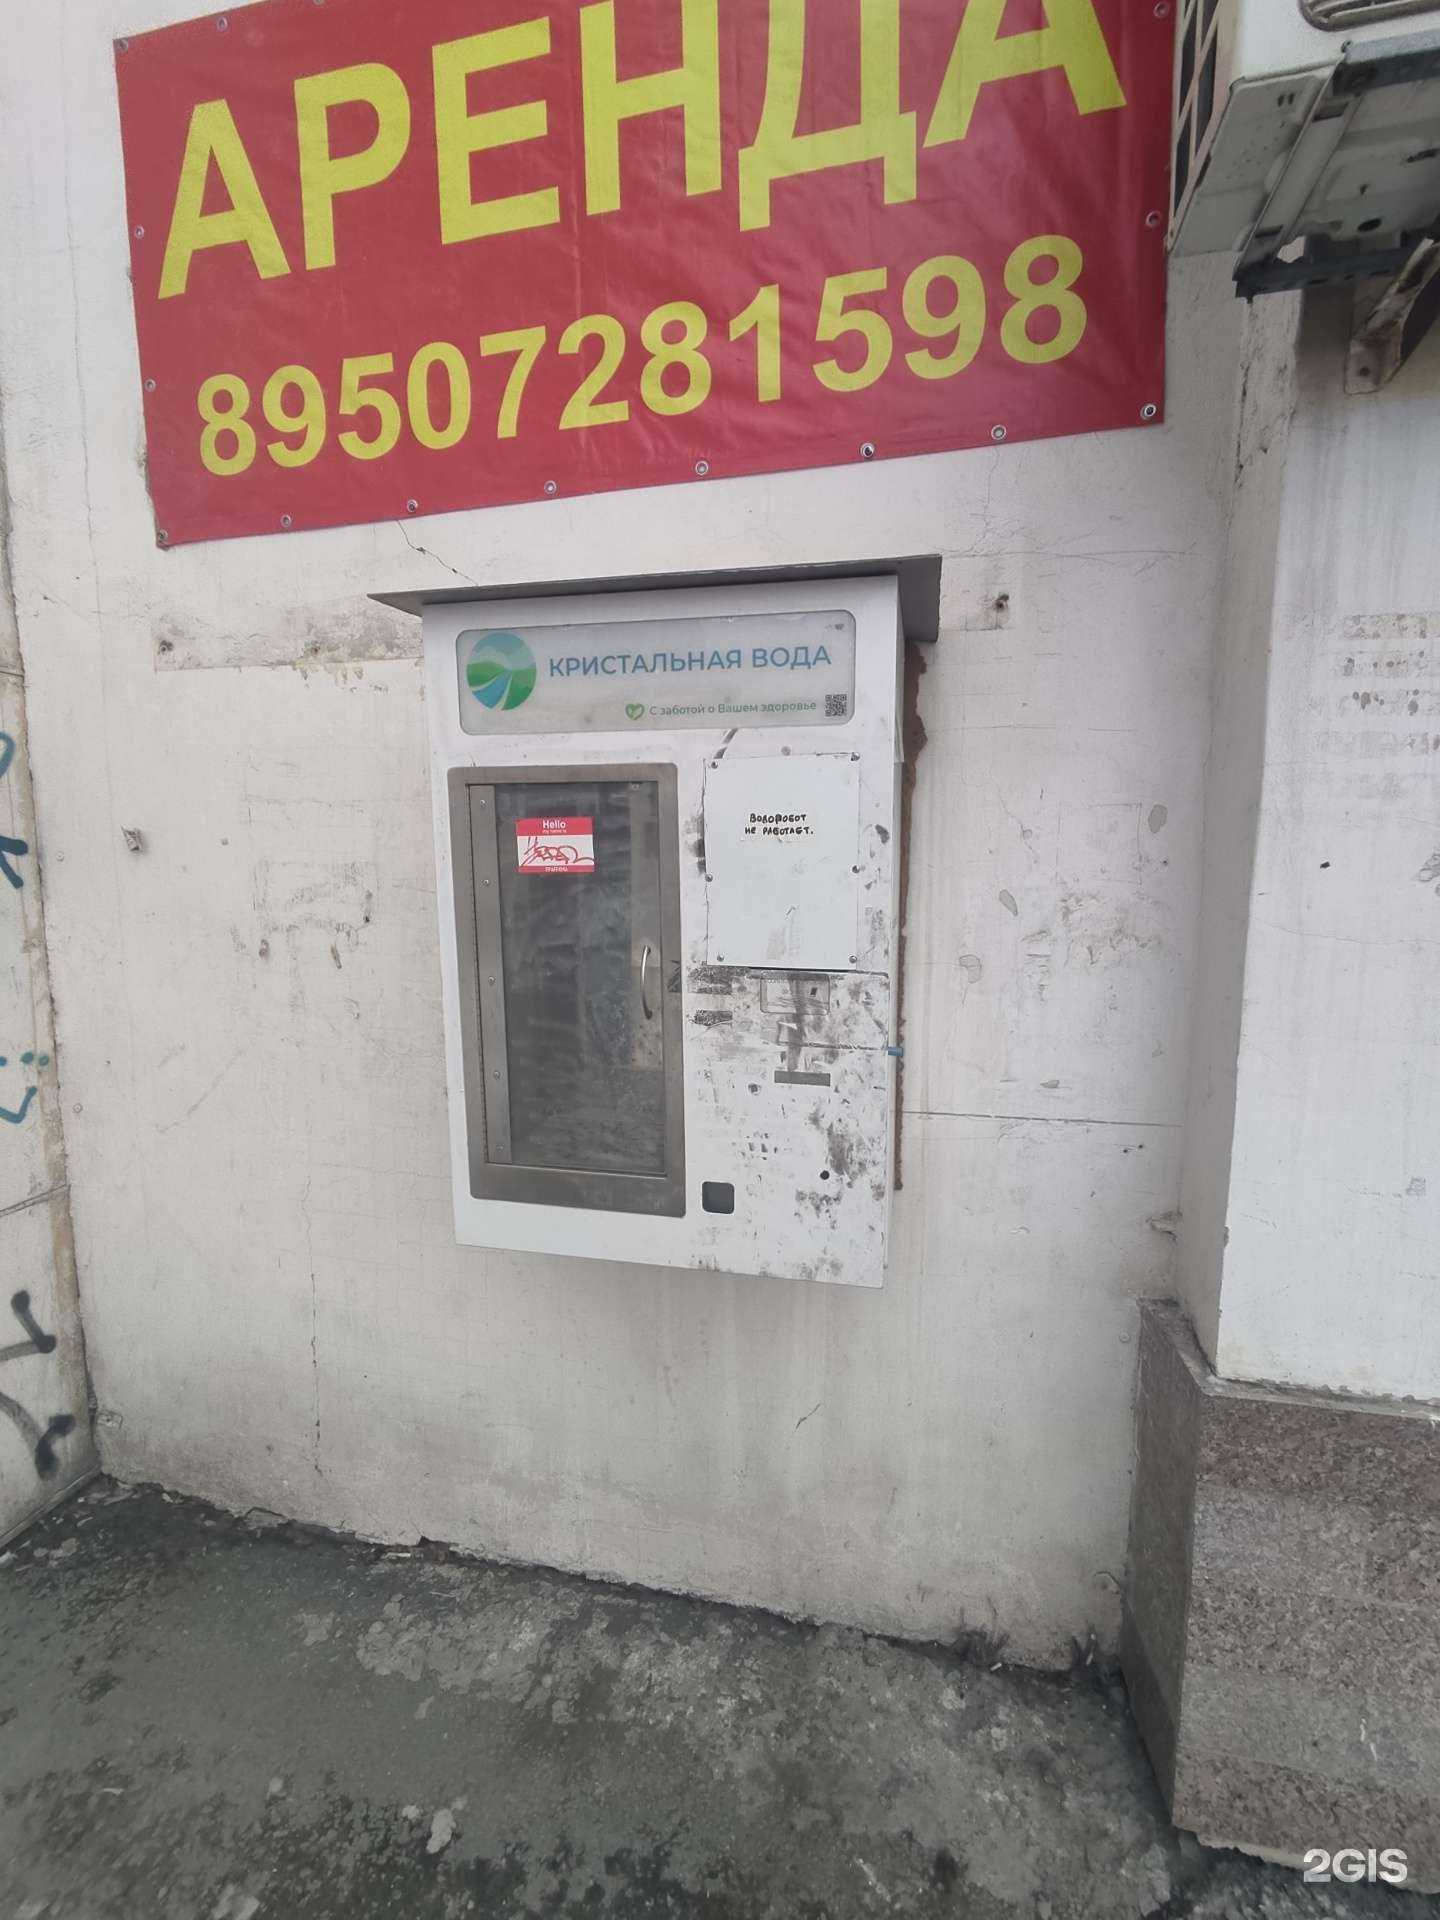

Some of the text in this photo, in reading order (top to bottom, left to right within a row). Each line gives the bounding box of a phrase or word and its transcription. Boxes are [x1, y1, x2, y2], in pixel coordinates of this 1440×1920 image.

[198, 235, 1088, 476] 89507281598
[549, 646, 831, 677] КРИСТАЛЬНАЯ ВОДА
[660, 704, 704, 716] заботой
[708, 705, 715, 714] о
[718, 702, 757, 714] Вашем
[761, 702, 817, 714] здоровье
[542, 819, 567, 830] Hello
[744, 826, 757, 835] НЕ
